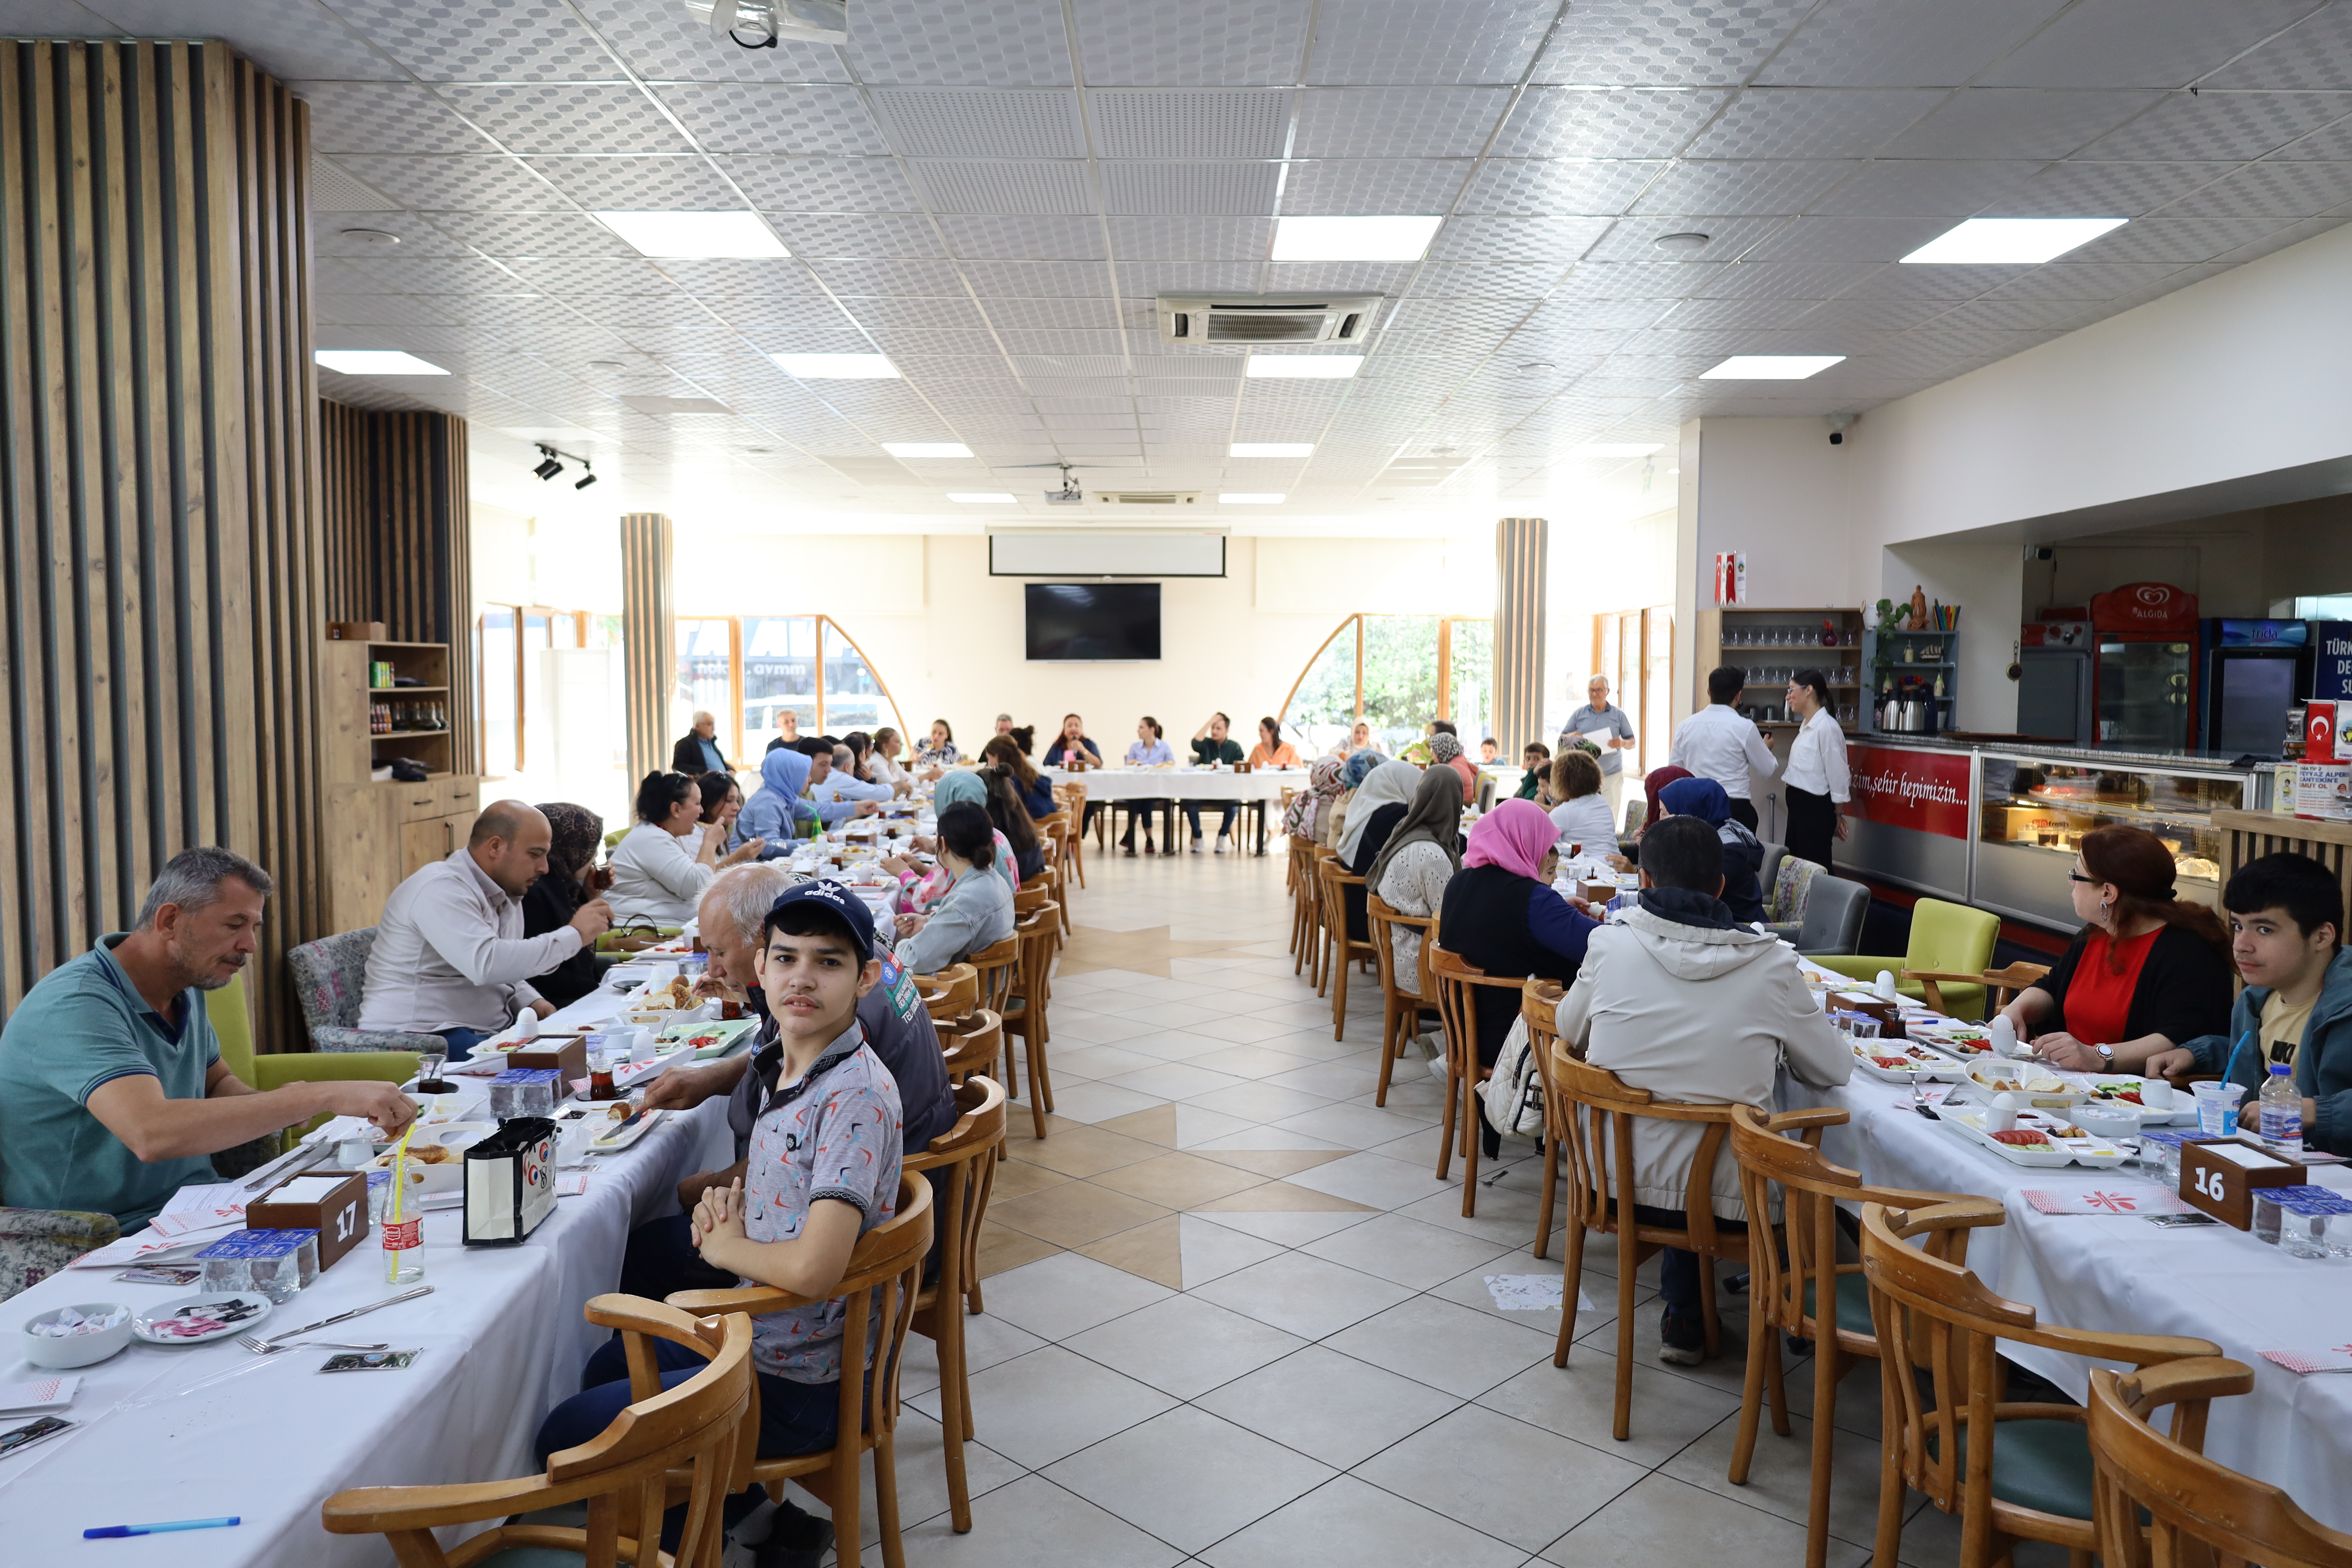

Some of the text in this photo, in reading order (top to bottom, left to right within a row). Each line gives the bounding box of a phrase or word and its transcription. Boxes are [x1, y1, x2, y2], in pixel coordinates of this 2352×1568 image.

[2252, 627, 2278, 639] frida
[1899, 772, 1967, 808] hepimizin...
[804, 889, 845, 905] adidas
[2195, 1167, 2224, 1202] 16
[337, 1200, 357, 1243] 17
